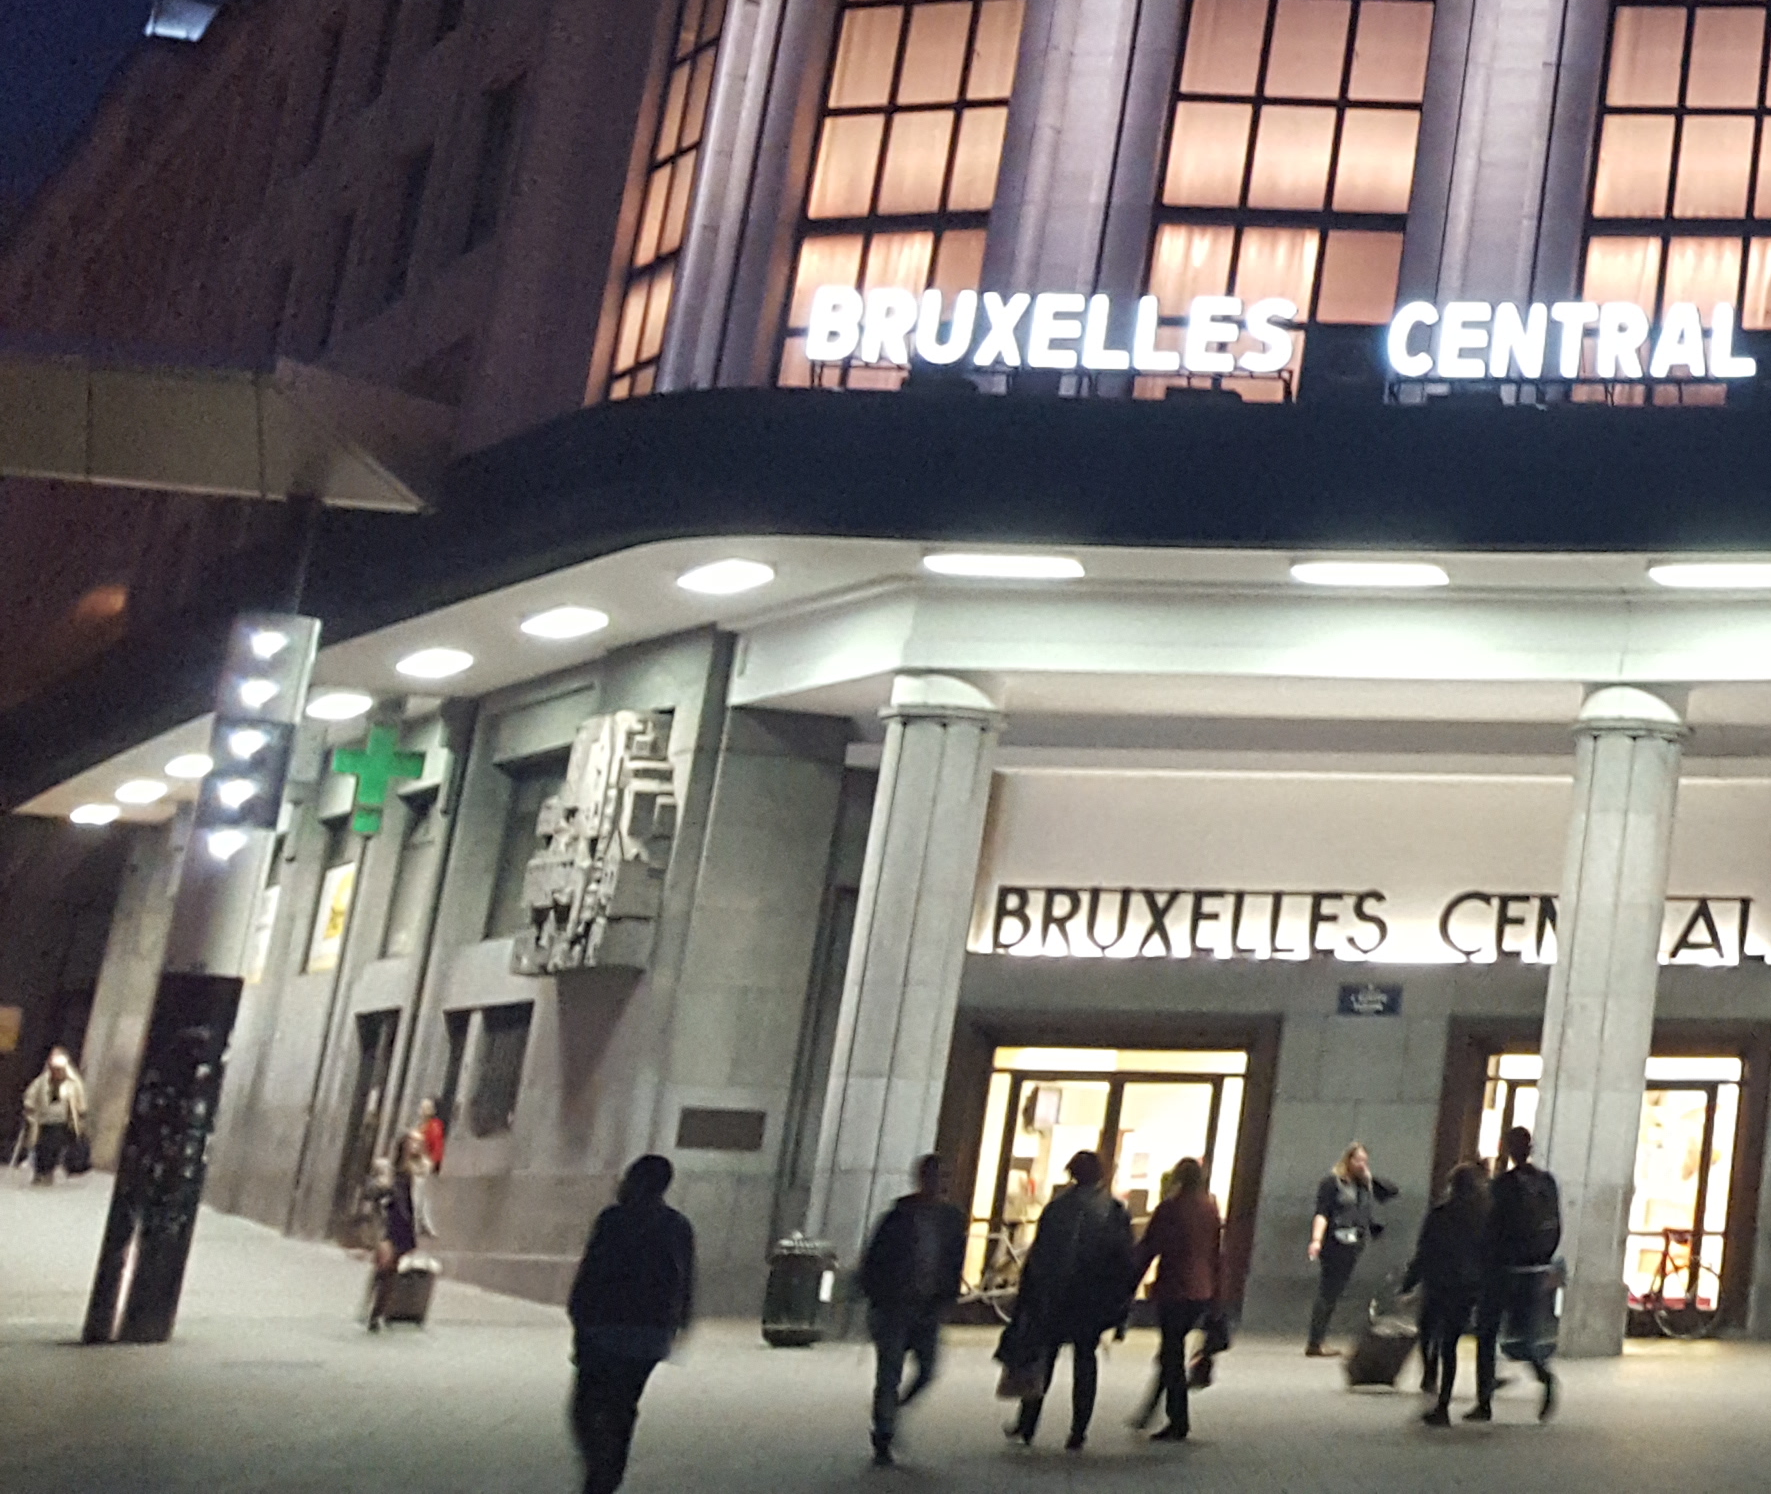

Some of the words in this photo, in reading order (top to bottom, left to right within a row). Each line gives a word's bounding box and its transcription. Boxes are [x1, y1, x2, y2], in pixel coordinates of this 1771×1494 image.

[804, 284, 1299, 375] BRUXELLES
[1386, 300, 1758, 381] CENTRAL
[993, 887, 1388, 955] BRUXELLES
[1439, 890, 1766, 961] CENAL
